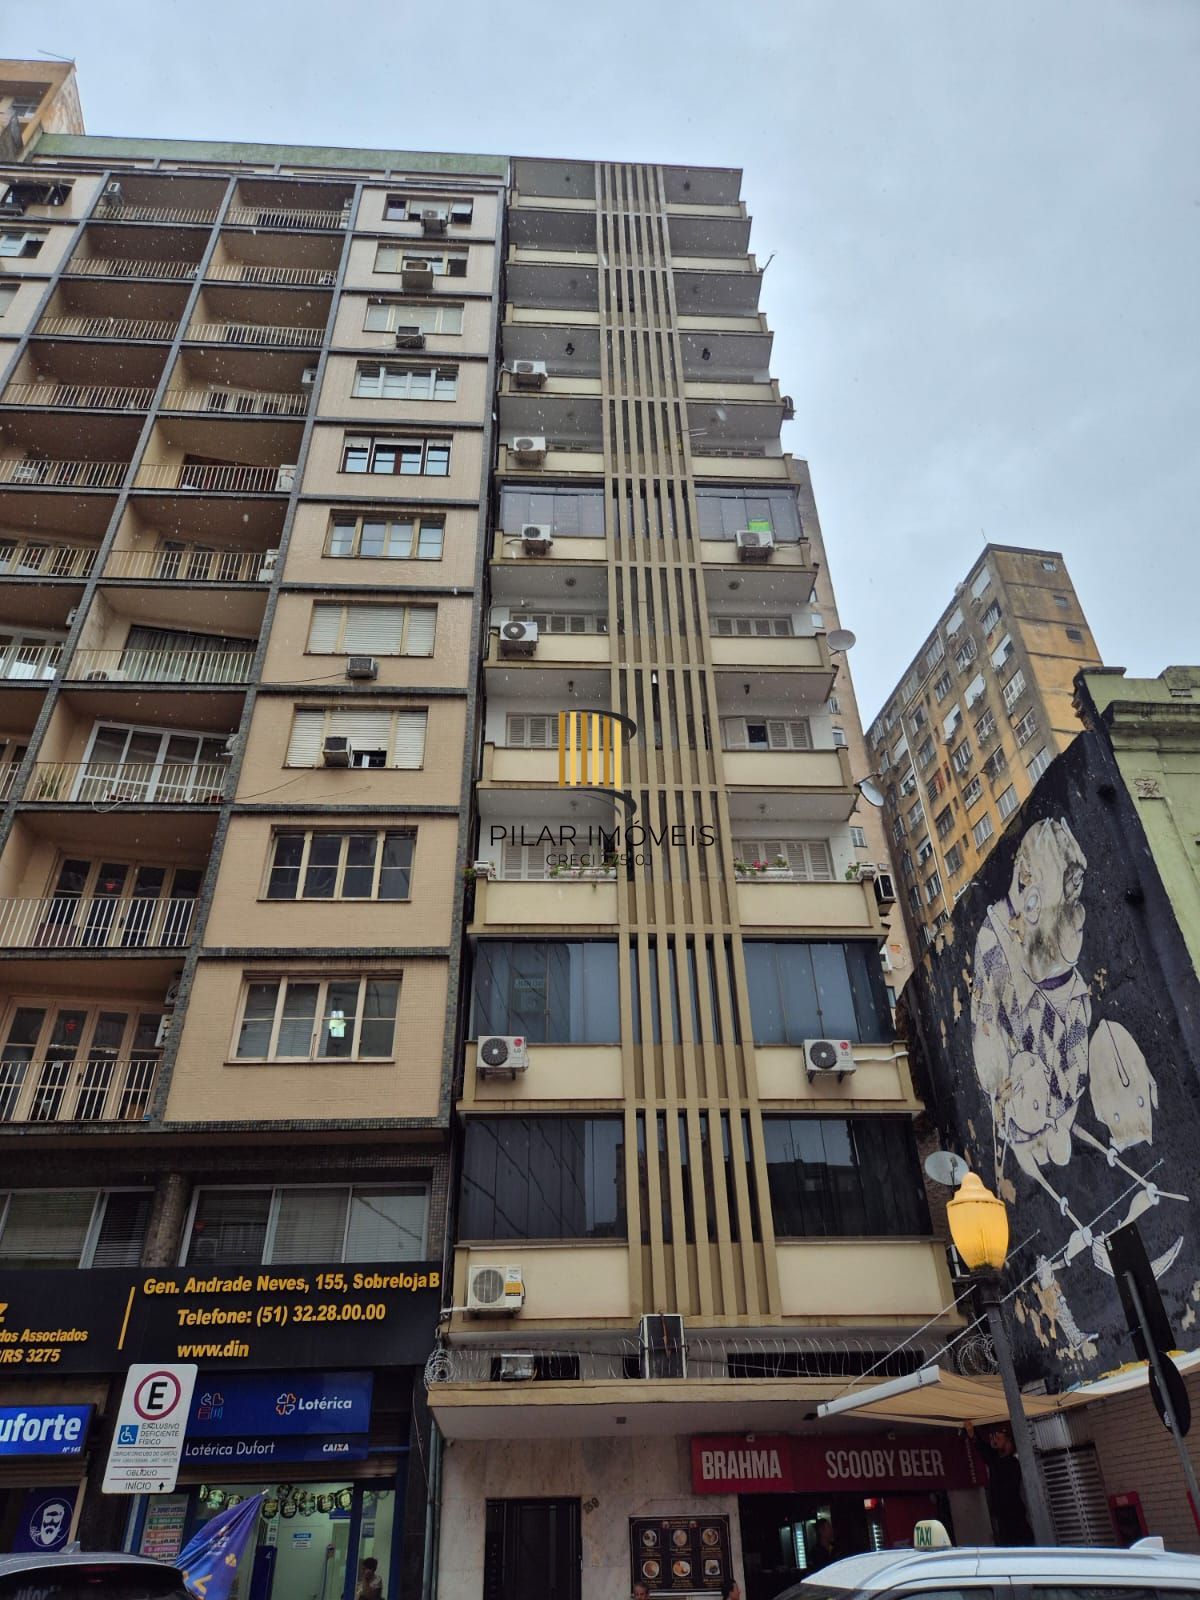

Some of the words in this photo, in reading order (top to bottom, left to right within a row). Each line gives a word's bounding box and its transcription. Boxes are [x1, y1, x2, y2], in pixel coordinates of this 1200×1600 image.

[143, 1278, 180, 1294] Gen.
[184, 1276, 252, 1293] Andrade
[256, 1275, 310, 1293] Neves,
[315, 1273, 349, 1293] 155,
[177, 1308, 252, 1326] Telefone:
[256, 1306, 288, 1327] (51)
[292, 1304, 386, 1322] 32.28.00.00
[20, 1328, 89, 1342] Associados
[26, 1348, 61, 1363] 3275
[177, 1340, 250, 1357] www.din
[146, 1382, 168, 1410] E
[298, 1396, 352, 1411] Lotérica
[141, 1422, 180, 1430] EXCLUSIVO
[185, 1441, 233, 1456] Lotérica
[236, 1440, 275, 1455] Dufort
[322, 1443, 350, 1452] CAIXA
[702, 1450, 783, 1480] BRAHMA
[825, 1449, 895, 1479] SCOOBY
[900, 1449, 945, 1477] BEER
[916, 1526, 932, 1546] TAXI
